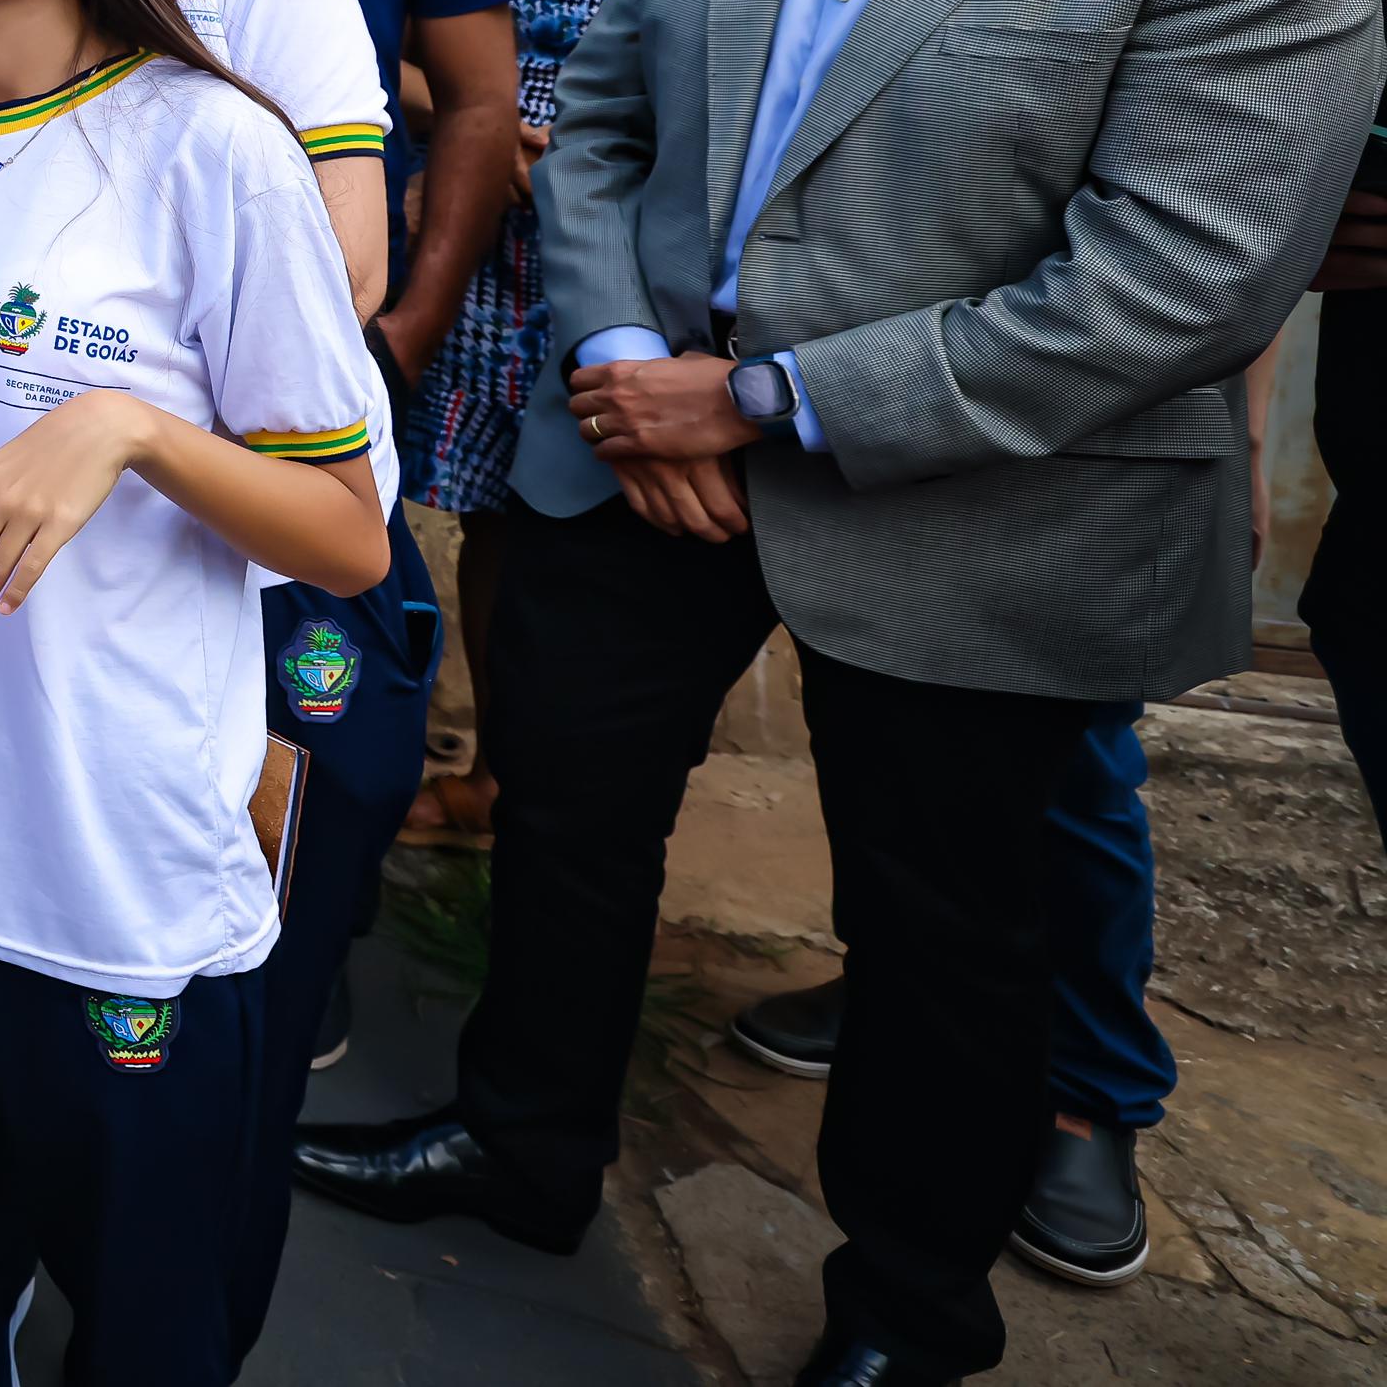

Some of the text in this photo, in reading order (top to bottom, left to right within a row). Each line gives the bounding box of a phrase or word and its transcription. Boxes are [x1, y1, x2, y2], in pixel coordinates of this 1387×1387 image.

[57, 316, 130, 344] ESTADO
[53, 335, 138, 363] DE GOIÁS
[5, 378, 61, 396] SECRETARIA
[39, 394, 64, 406] EDUC
